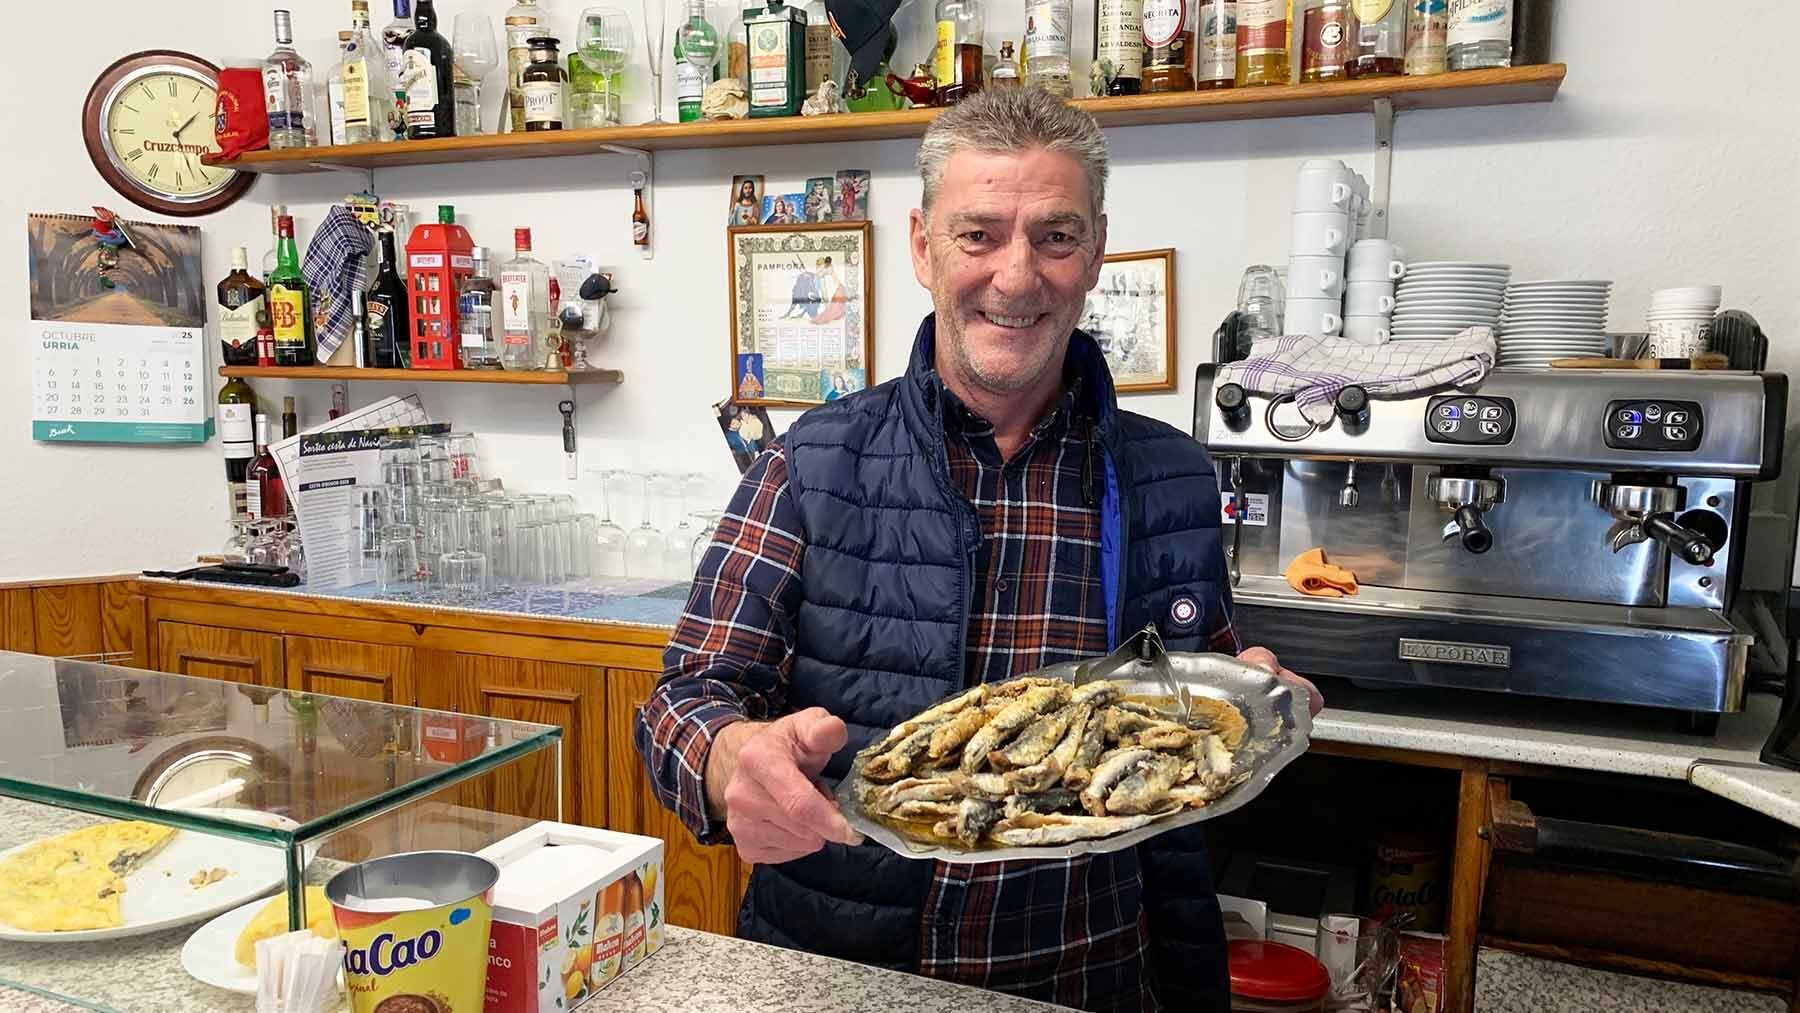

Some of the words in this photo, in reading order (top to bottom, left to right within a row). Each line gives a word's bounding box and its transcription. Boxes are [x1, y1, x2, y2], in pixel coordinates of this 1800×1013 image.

[143, 140, 210, 156] Cruzcampo
[757, 263, 806, 271] PAMPLONA
[42, 330, 97, 343] OCTUBRE
[43, 341, 80, 351] URRIA
[183, 372, 193, 381] 12
[47, 380, 57, 389] 13
[71, 380, 81, 389] 14
[95, 382, 104, 391] 15
[117, 383, 127, 392] 16
[140, 383, 149, 393] 17
[183, 384, 193, 393] 19
[46, 392, 60, 402] 20
[71, 393, 81, 402] 21
[94, 394, 105, 403] 22
[183, 396, 195, 405] 26
[47, 405, 58, 415] 27
[70, 406, 82, 415] 28
[94, 407, 105, 416] 29
[303, 440, 326, 454] Sorteo
[327, 441, 346, 451] cesta
[347, 436, 357, 449] de
[1402, 642, 1507, 665] EXPOBAR
[342, 930, 442, 976] laCao
